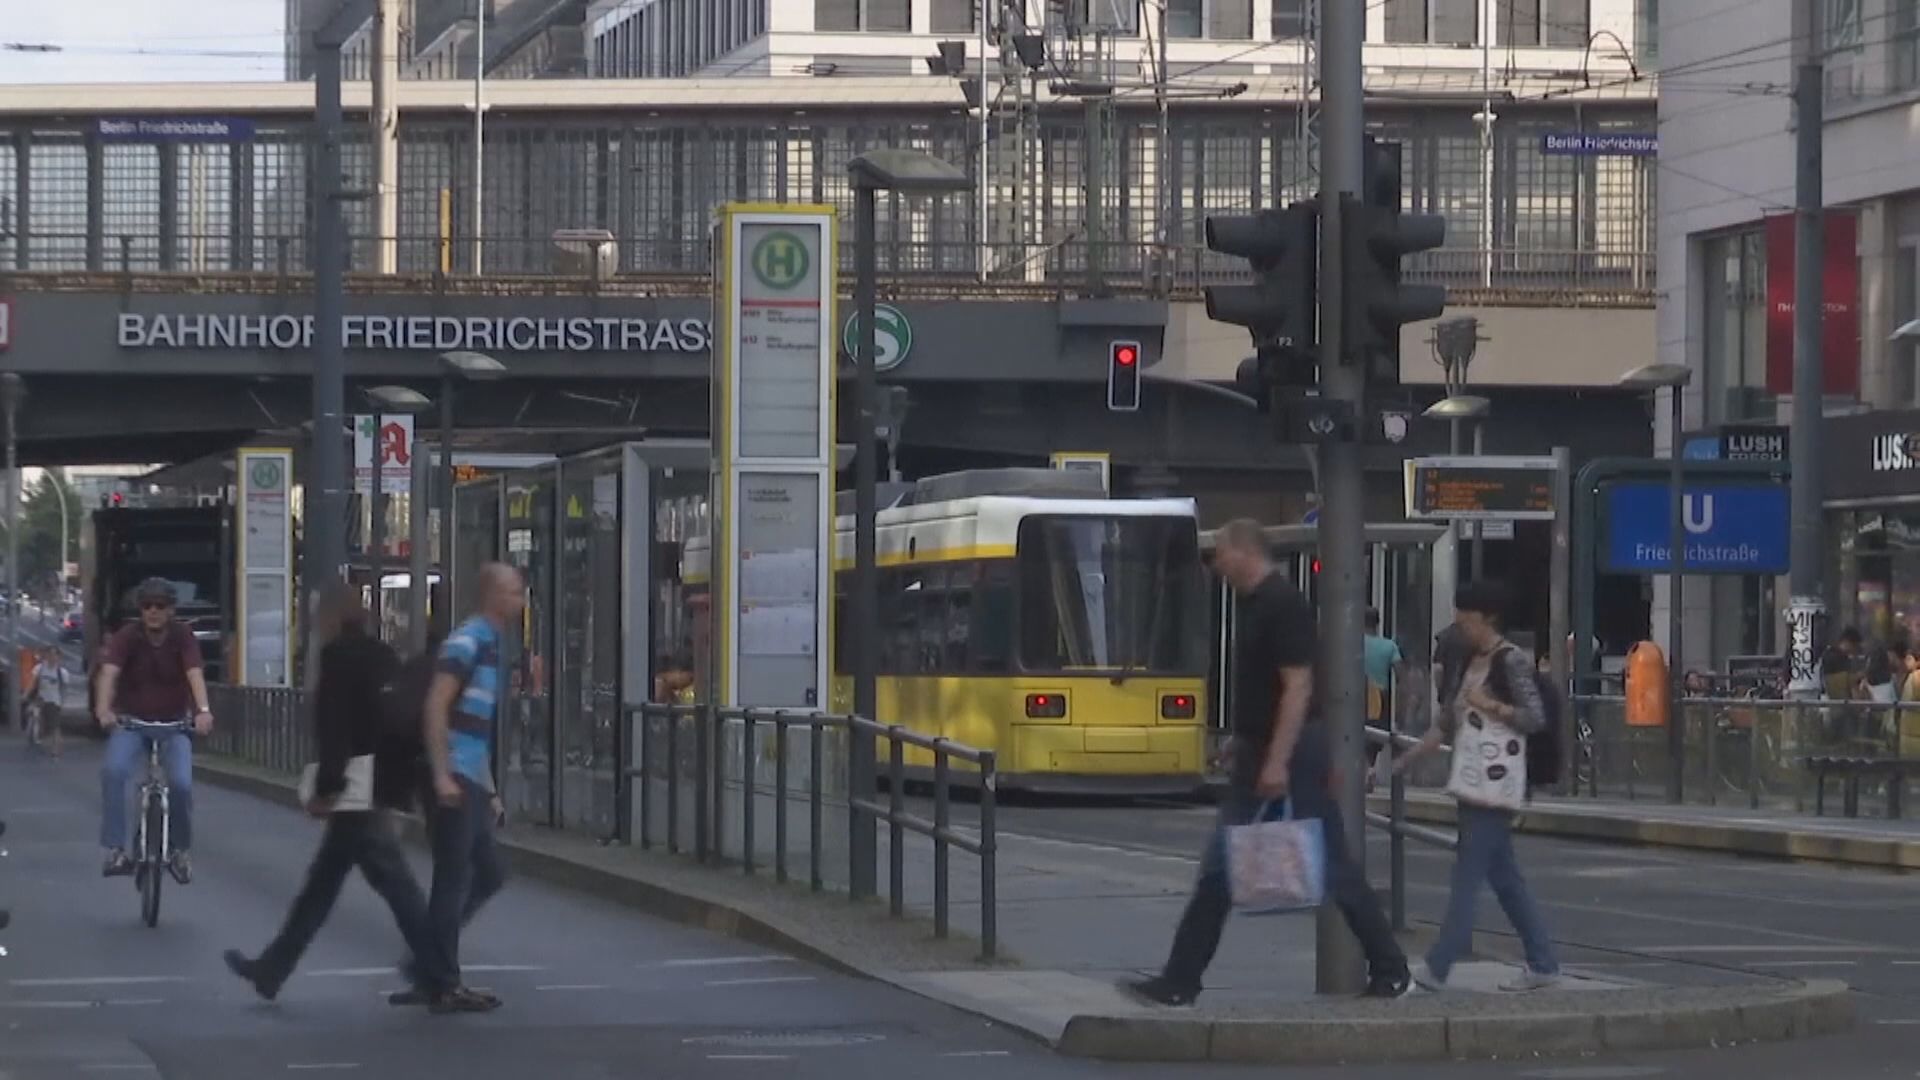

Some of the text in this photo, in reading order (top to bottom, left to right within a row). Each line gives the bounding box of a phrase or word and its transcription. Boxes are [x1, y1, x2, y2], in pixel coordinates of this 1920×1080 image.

[100, 120, 229, 134] Berlin Friedrichstraße
[1546, 135, 1582, 149] Berlin
[766, 244, 795, 277] H
[341, 315, 713, 351] FRIEDRICHSTRAS
[1728, 435, 1782, 452] LUSH
[1682, 494, 1713, 534] U
